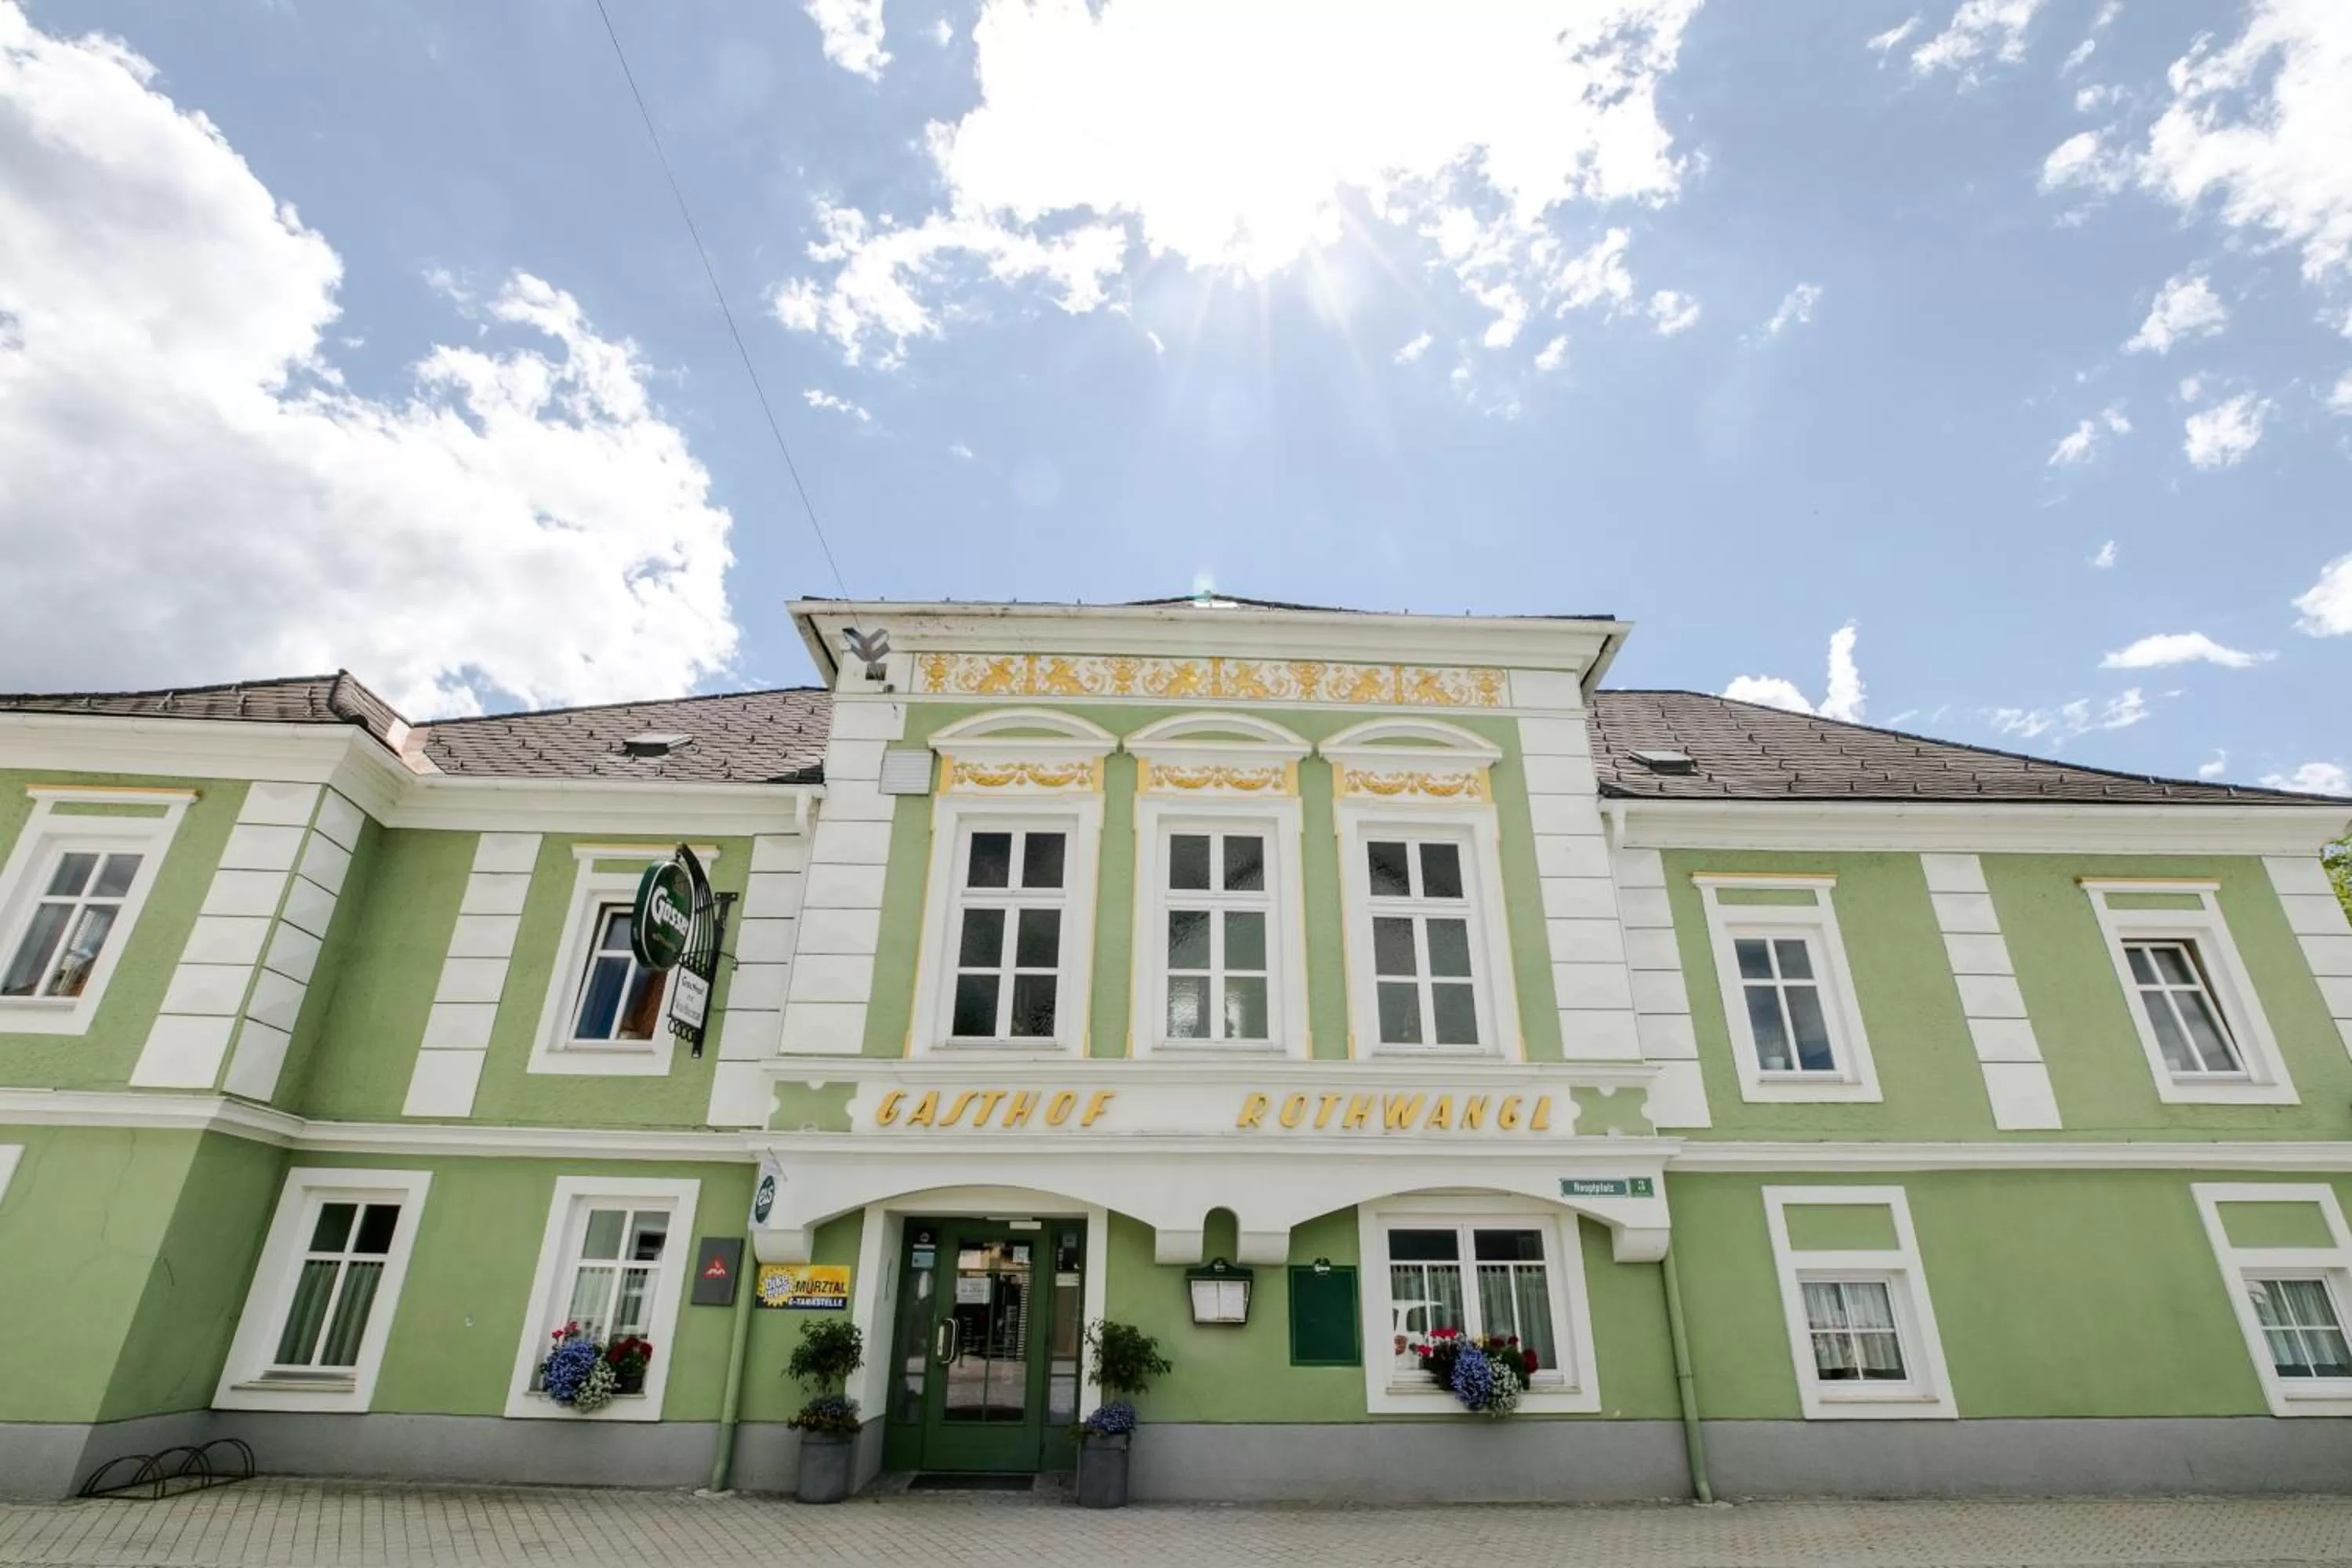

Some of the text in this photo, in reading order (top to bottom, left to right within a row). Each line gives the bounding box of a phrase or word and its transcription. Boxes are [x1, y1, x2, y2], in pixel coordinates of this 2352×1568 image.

[651, 885, 690, 938] Gösse
[876, 1091, 1552, 1130] GASTHOF ROTHWANGL
[1573, 1181, 1615, 1195] Hauptplatz
